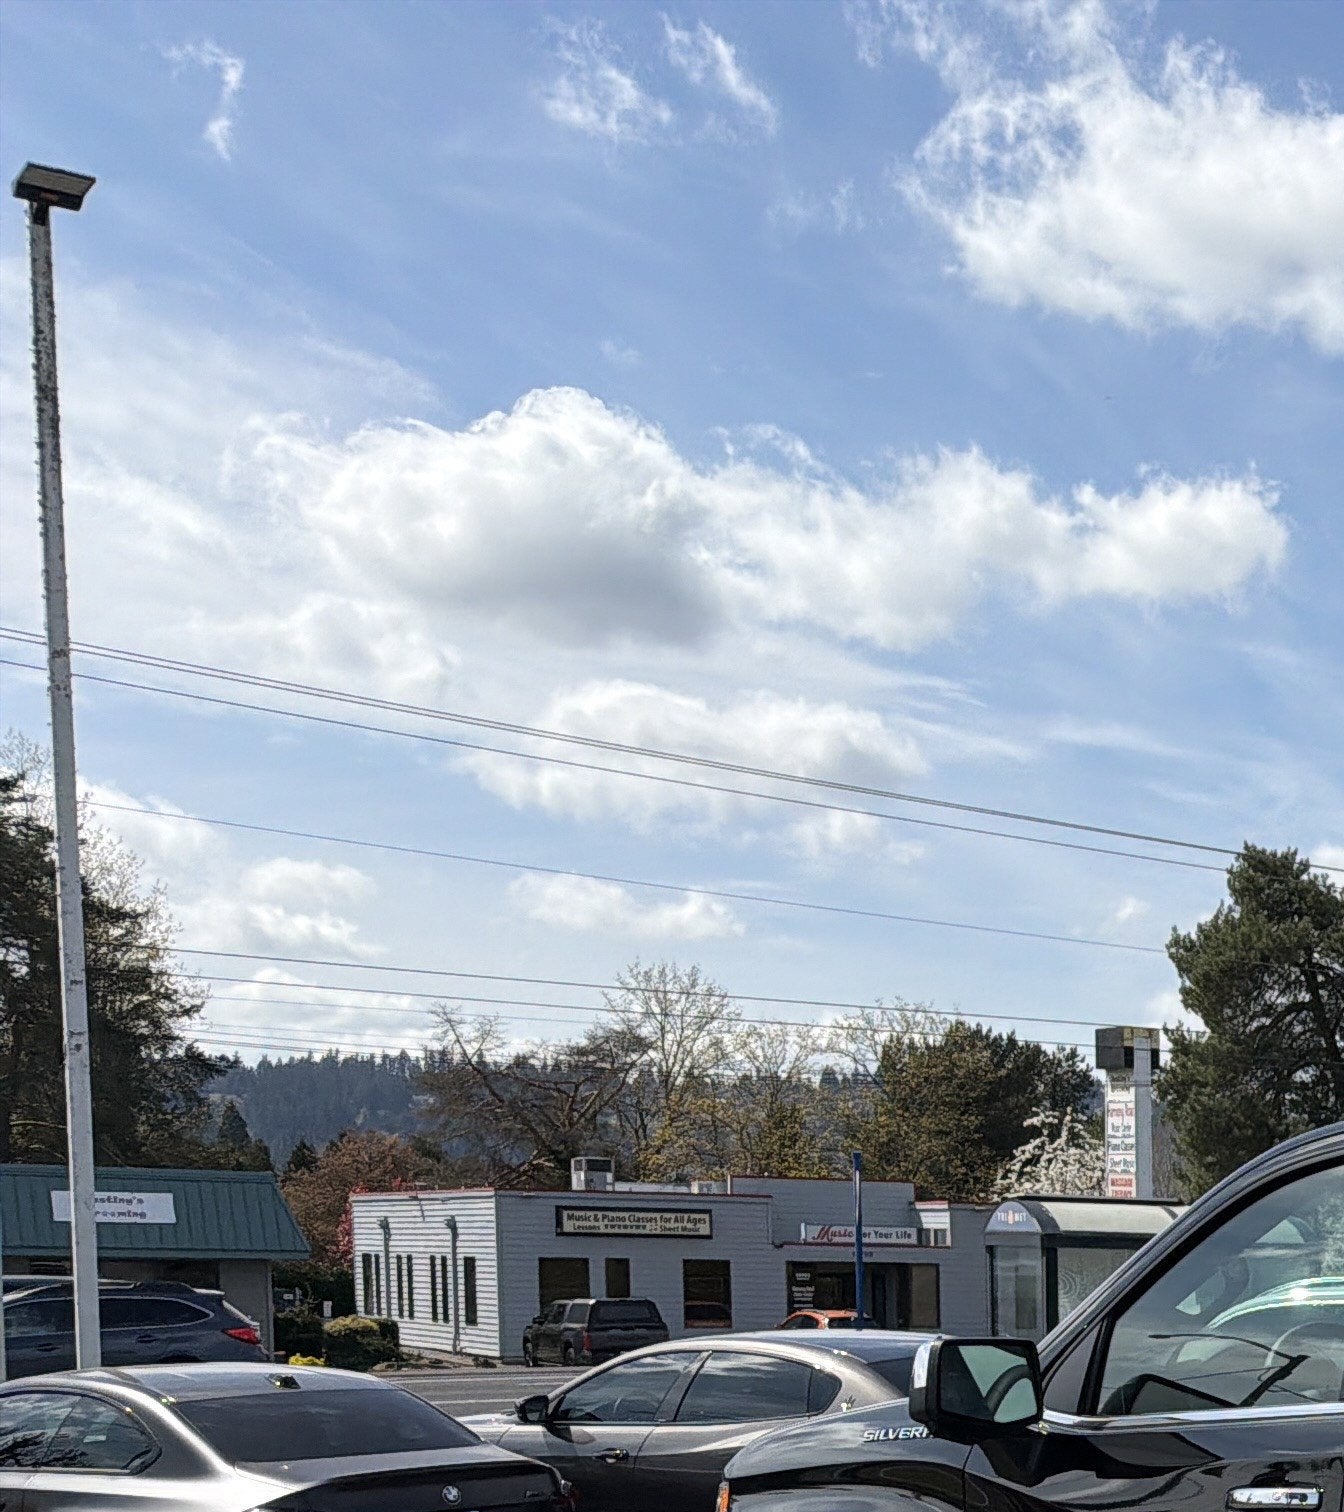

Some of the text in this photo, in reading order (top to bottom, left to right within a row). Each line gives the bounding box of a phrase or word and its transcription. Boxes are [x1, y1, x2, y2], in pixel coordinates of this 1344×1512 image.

[567, 1212, 707, 1227] Music & Piano Classes for All Ages
[811, 1225, 855, 1242] Music
[873, 1230, 894, 1240] Your
[896, 1230, 912, 1239] Life
